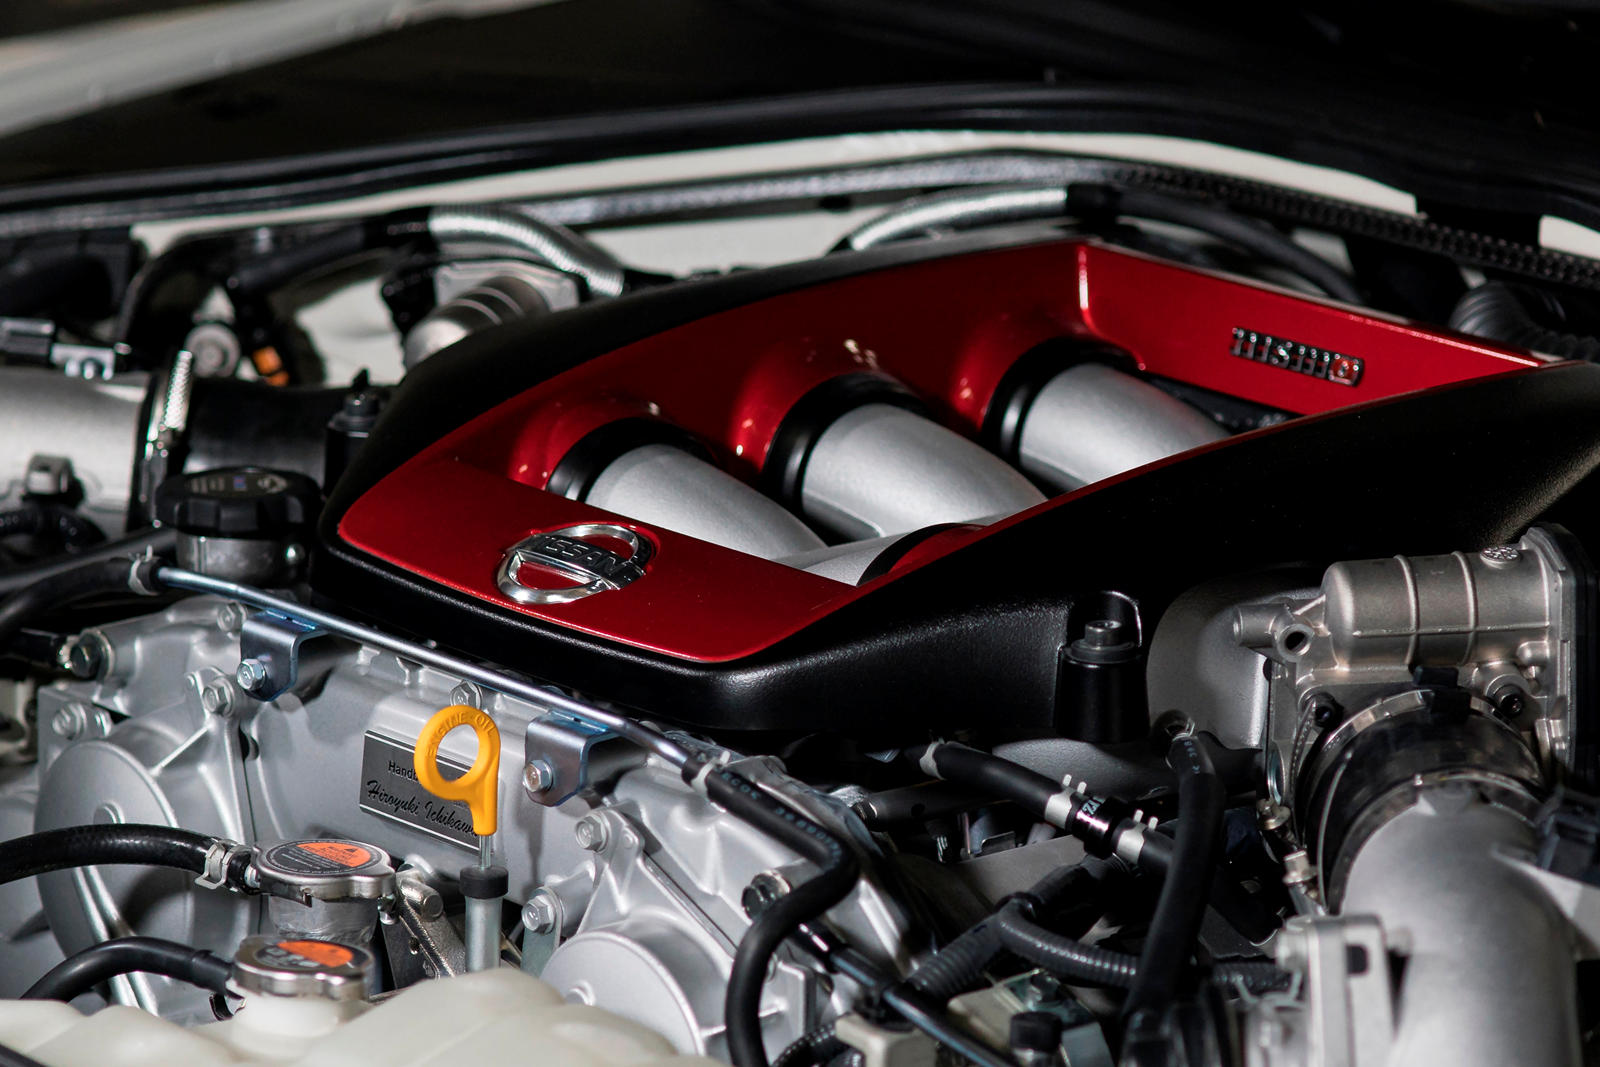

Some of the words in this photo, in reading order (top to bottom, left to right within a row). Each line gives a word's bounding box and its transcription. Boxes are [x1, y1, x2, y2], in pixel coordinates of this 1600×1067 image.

[427, 711, 468, 758] ENGINE
[474, 713, 497, 736] OIL
[367, 780, 420, 814] Hiroyuki
